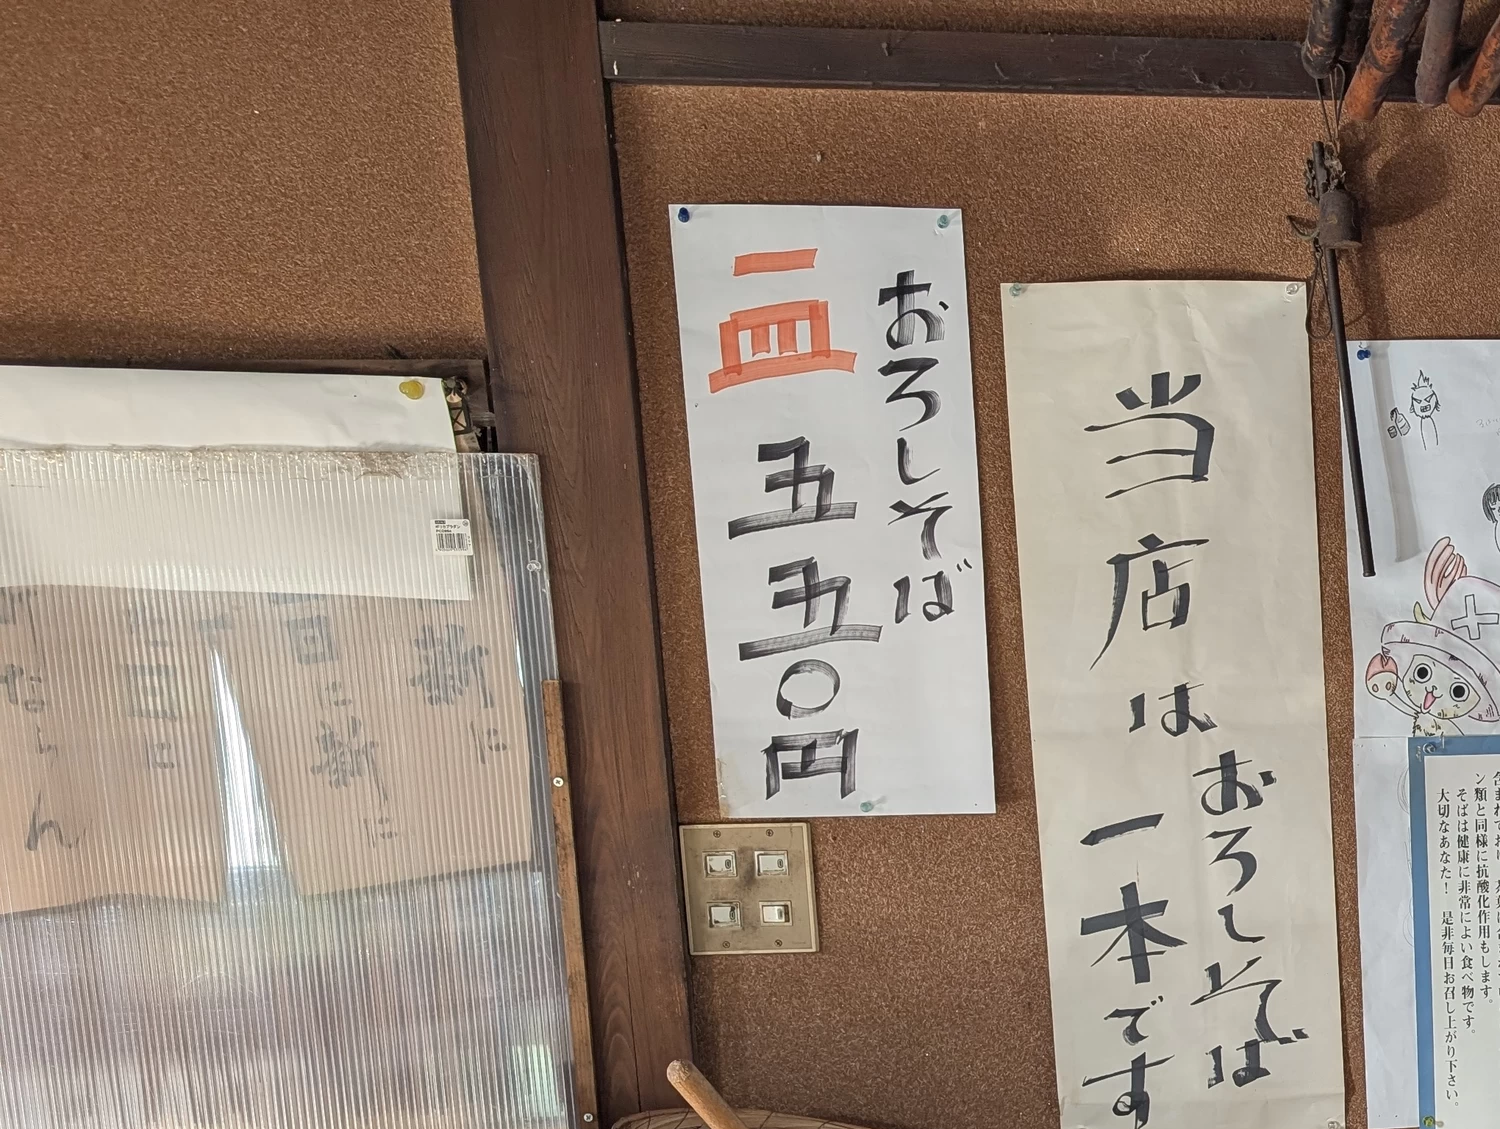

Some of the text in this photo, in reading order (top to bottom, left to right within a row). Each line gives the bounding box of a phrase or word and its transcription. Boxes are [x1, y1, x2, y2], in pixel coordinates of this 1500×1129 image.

[708, 248, 883, 800] 一皿 五五〇円
[878, 270, 972, 623] おろしそば
[1084, 372, 1218, 736] 当店は
[1190, 749, 1310, 1088] おろしそば
[1456, 788, 1475, 1034] そばは健康に非常によい食べ物です。
